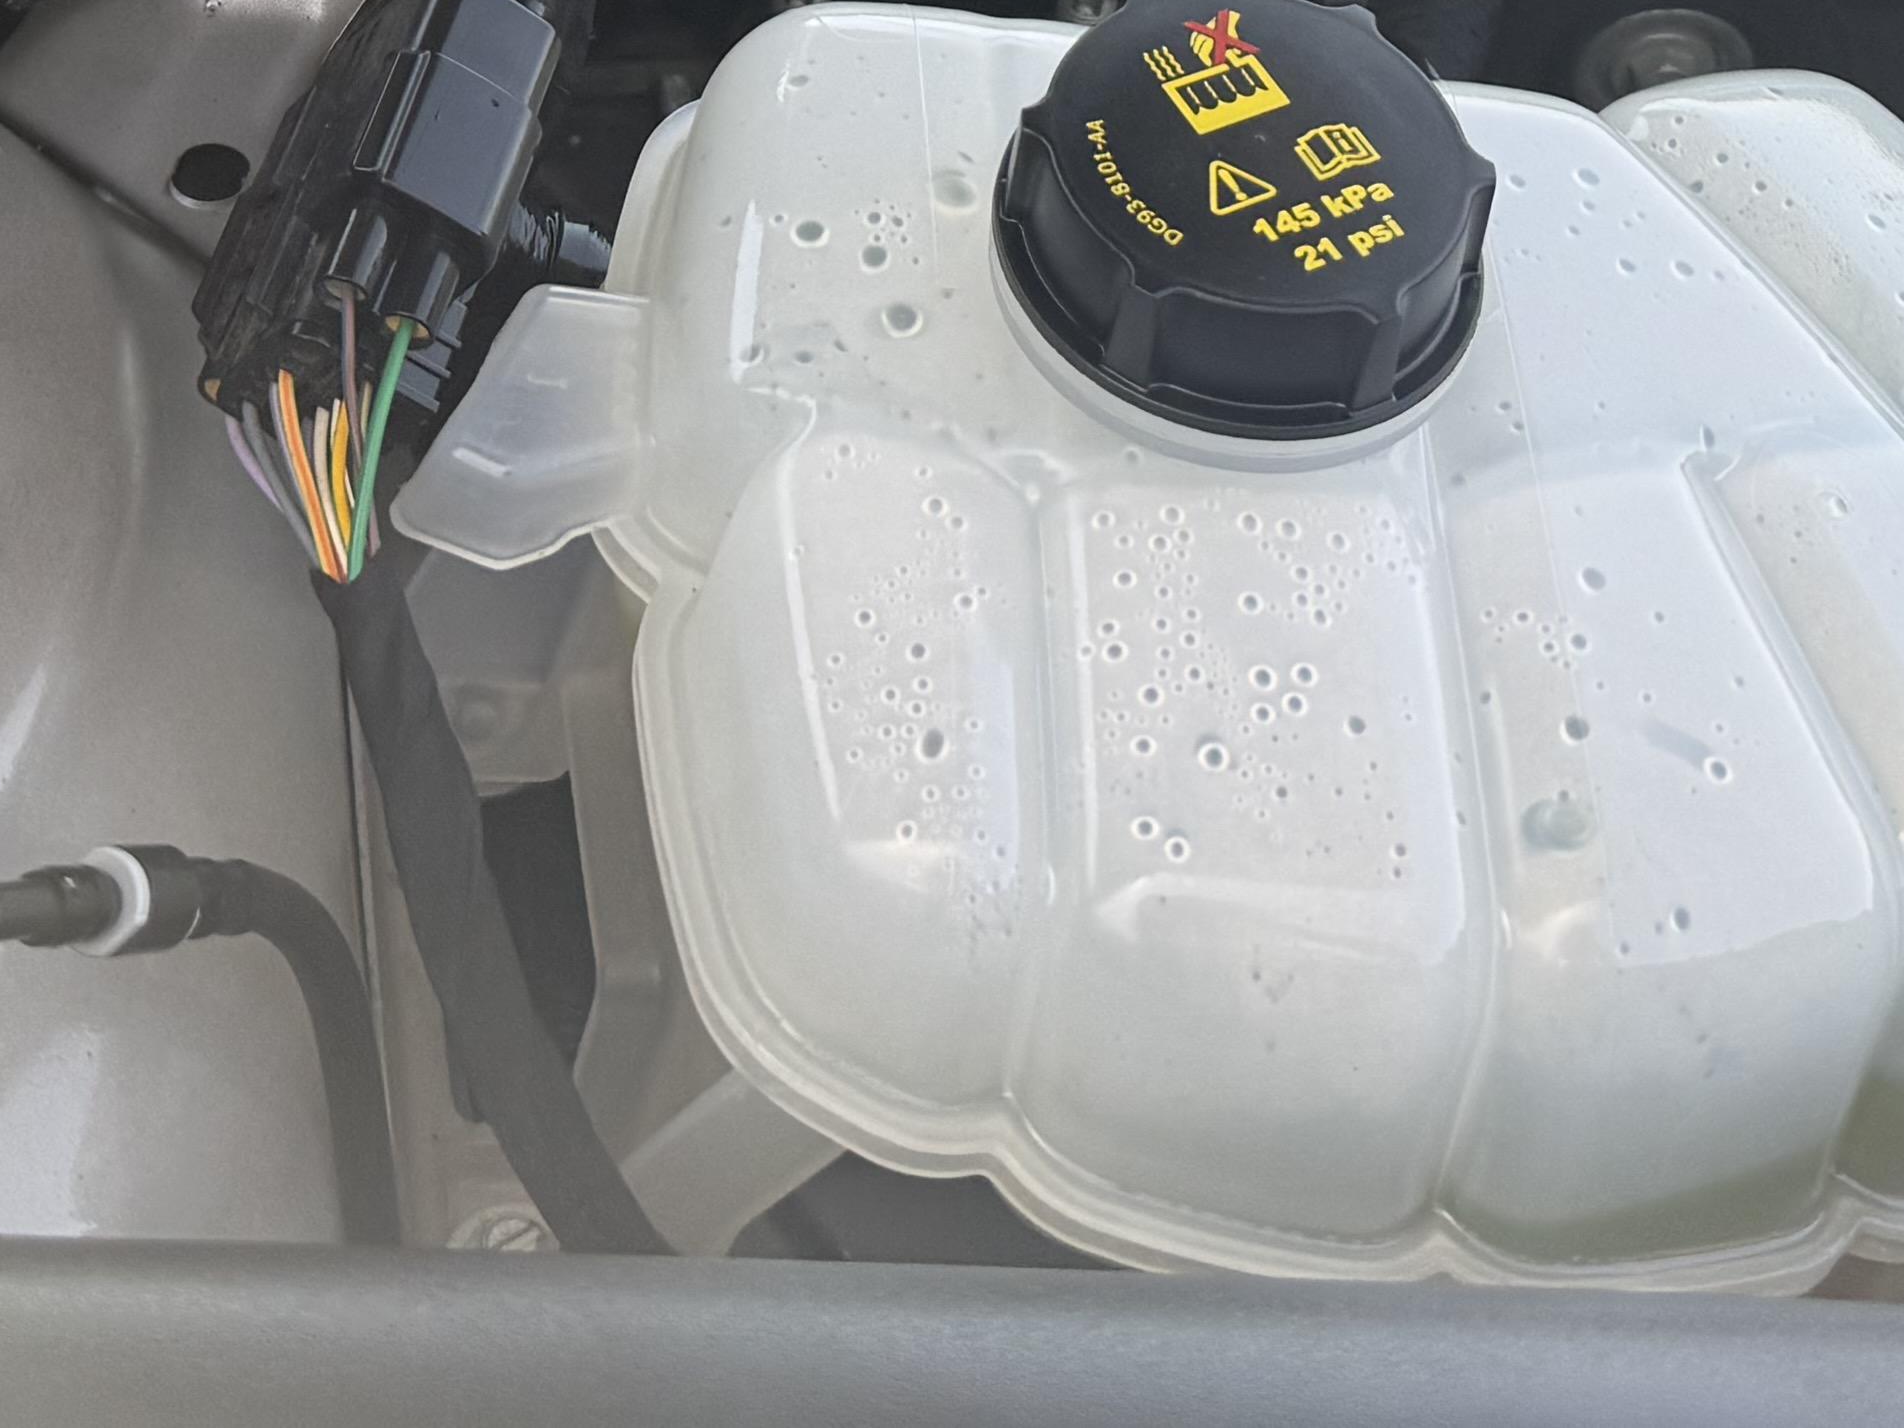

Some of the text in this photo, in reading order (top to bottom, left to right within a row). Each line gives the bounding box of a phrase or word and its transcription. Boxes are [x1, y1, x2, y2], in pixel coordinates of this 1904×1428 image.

[1085, 118, 1184, 247] DG93-8101-AA
[1253, 182, 1395, 242] 145 kPa
[1293, 213, 1406, 273] 21 psi
